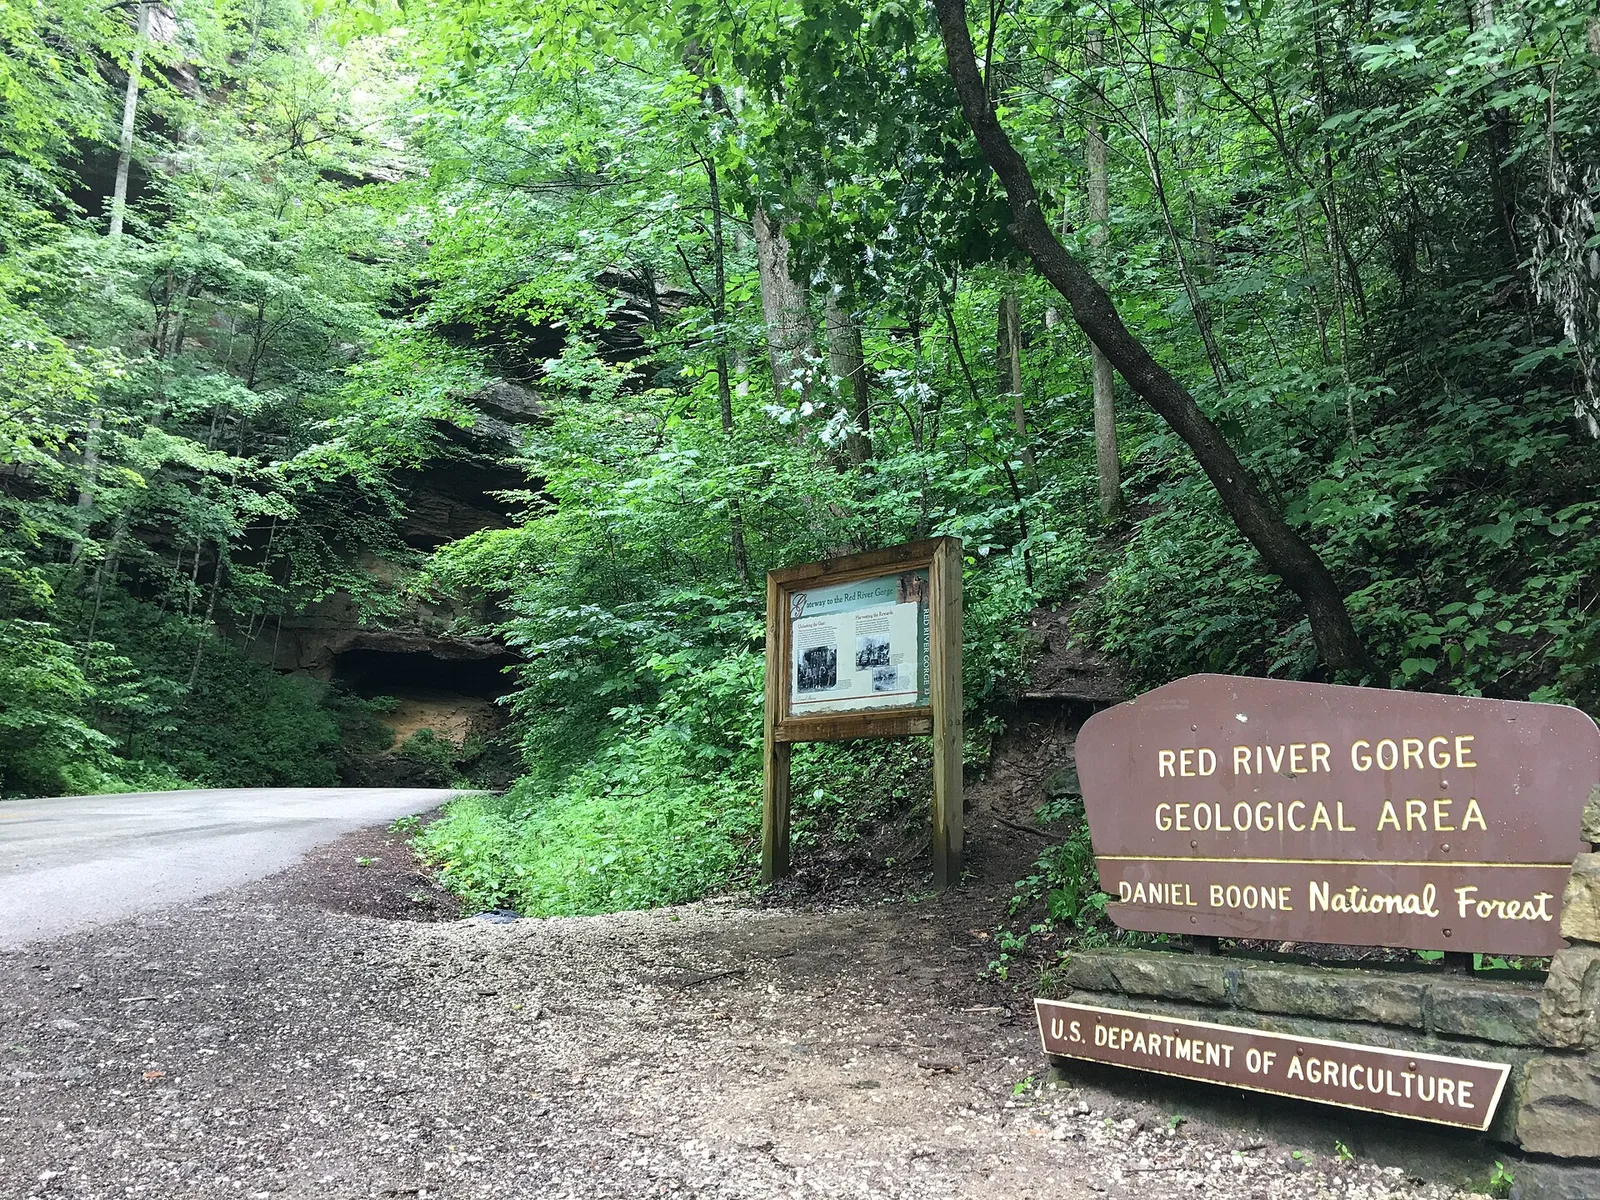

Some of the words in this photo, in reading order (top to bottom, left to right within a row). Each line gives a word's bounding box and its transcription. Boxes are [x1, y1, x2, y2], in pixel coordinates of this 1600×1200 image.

[791, 593, 826, 618] Gateway
[834, 595, 843, 604] the
[844, 593, 856, 602] Red
[857, 590, 874, 600] River
[874, 587, 894, 597] Gorge
[1158, 749, 1217, 778] RED
[1232, 742, 1331, 776] RIVER
[1350, 735, 1478, 772] GORGE
[1154, 800, 1356, 832] GEOLOGICAL
[1376, 797, 1488, 832] AREA
[1118, 881, 1198, 907] DANIEL
[1209, 884, 1293, 911] BOONE
[1308, 881, 1440, 918] National
[1453, 886, 1554, 921] Forest
[1050, 1018, 1087, 1045] U.S.
[1094, 1025, 1235, 1070] DEPARTMENT
[1245, 1048, 1278, 1076] OF
[1286, 1055, 1476, 1109] AGRICULTURE
